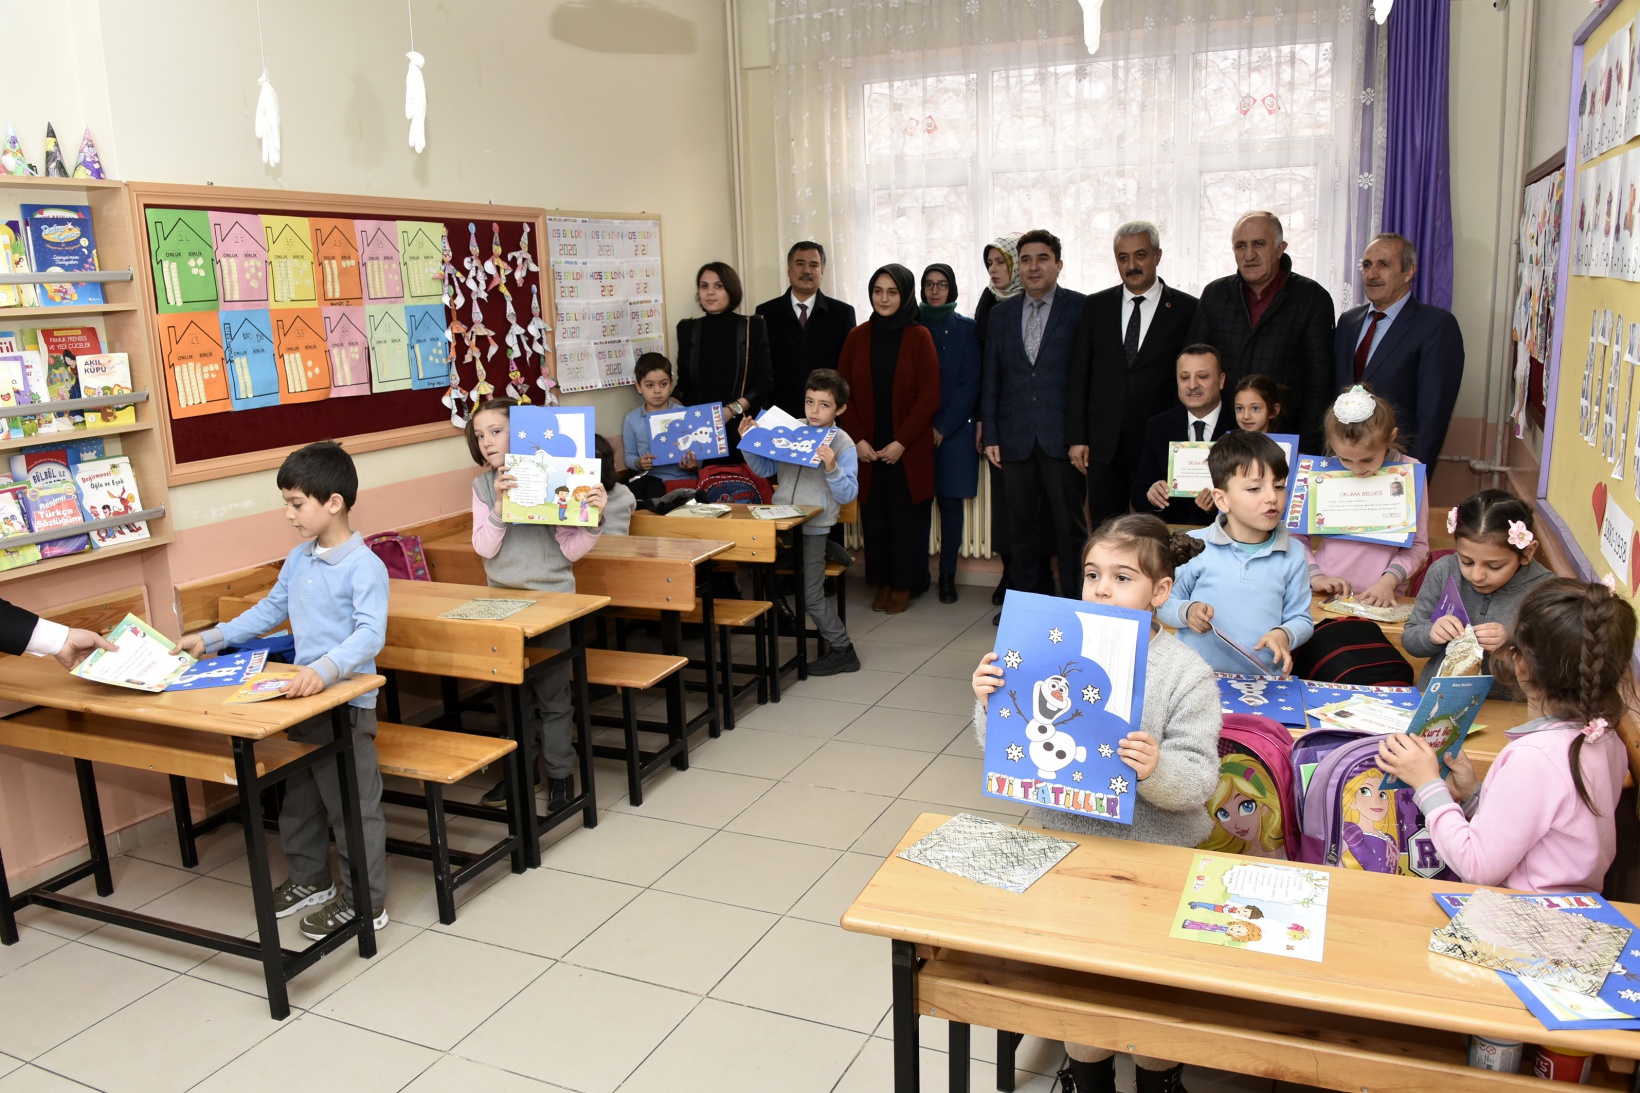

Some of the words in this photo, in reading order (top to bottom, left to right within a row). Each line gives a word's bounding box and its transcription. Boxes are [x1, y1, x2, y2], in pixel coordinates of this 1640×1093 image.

[558, 243, 578, 256] 2020
[560, 286, 579, 298] 2020
[562, 326, 580, 339] 2020
[602, 324, 619, 337] 2020
[637, 322, 653, 335] 2020
[84, 365, 107, 374] KÜPÜ
[605, 362, 622, 376] 2020
[32, 467, 57, 484] BÜLBÜL
[81, 471, 112, 483] Değirmenci
[90, 480, 104, 490] Oğlu
[112, 478, 124, 487] Eşek
[39, 495, 66, 509] Resimli
[38, 508, 74, 519] Türkçe
[36, 515, 83, 528] Sözlüğüm
[1421, 728, 1441, 738] Kurt
[1442, 726, 1452, 736] ile
[986, 774, 1014, 797] İYİ
[1020, 780, 1120, 817] TATİLLER
[1415, 839, 1440, 868] R
